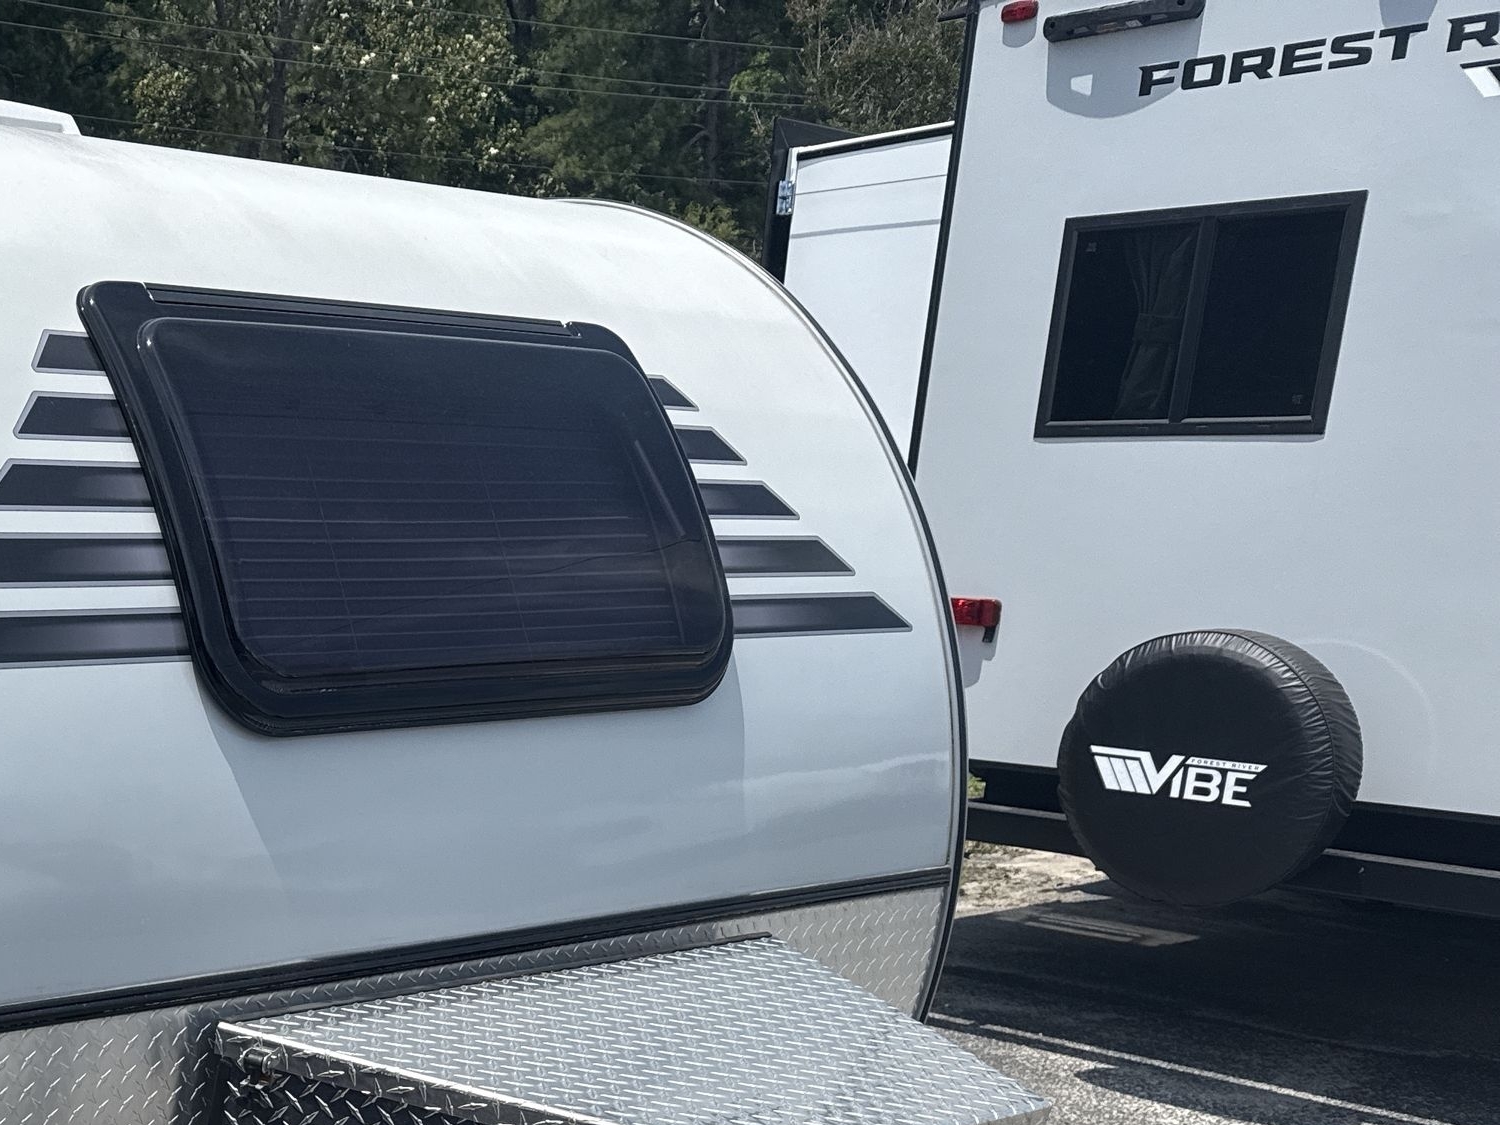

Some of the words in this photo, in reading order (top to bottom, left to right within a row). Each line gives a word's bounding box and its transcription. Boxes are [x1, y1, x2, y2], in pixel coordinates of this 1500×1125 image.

[1138, 22, 1429, 97] FOREST
[1089, 744, 1258, 808] VIBE
[1191, 758, 1226, 767] FOREST
[1231, 763, 1260, 771] RIVER
